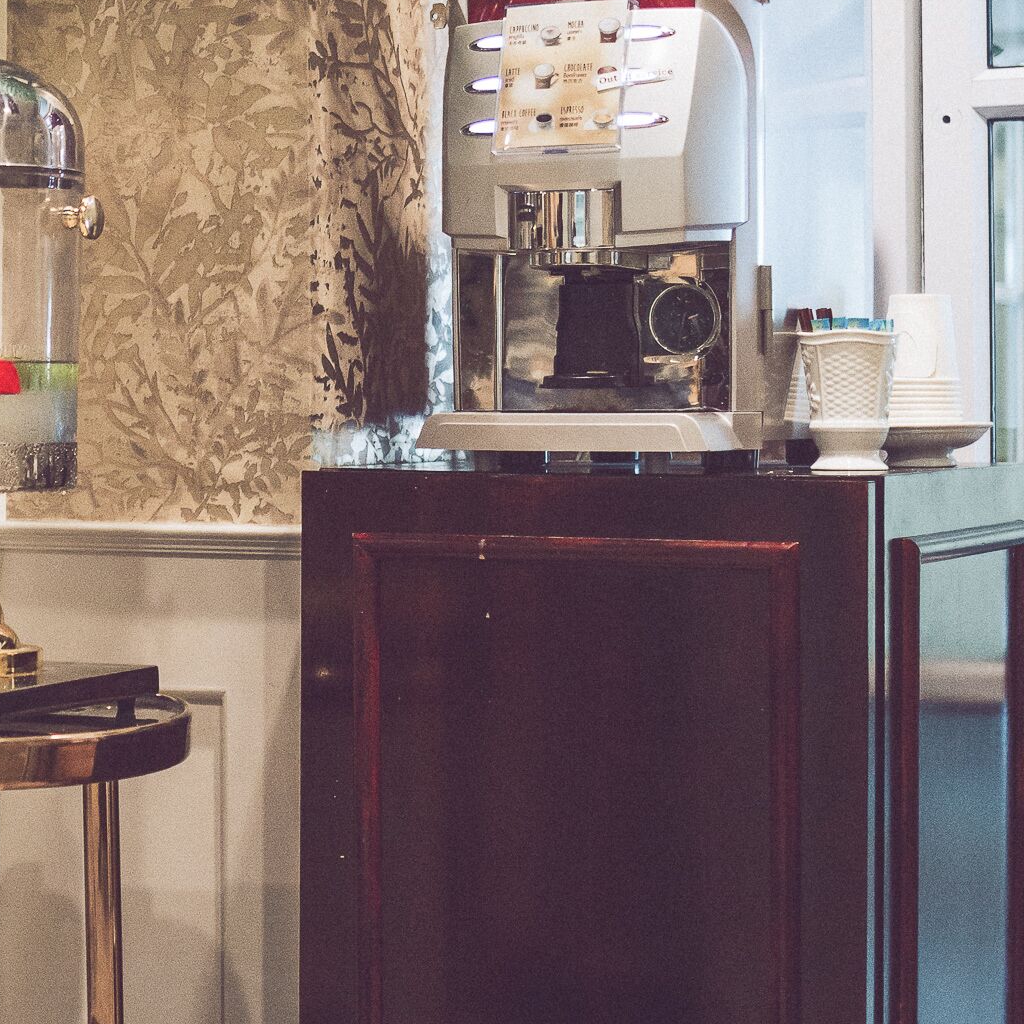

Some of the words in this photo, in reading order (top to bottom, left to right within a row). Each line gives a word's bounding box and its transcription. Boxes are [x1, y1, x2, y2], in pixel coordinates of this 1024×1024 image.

[505, 67, 521, 77] LATTE
[599, 75, 618, 85] Out
[560, 105, 585, 115] ESPRESSO
